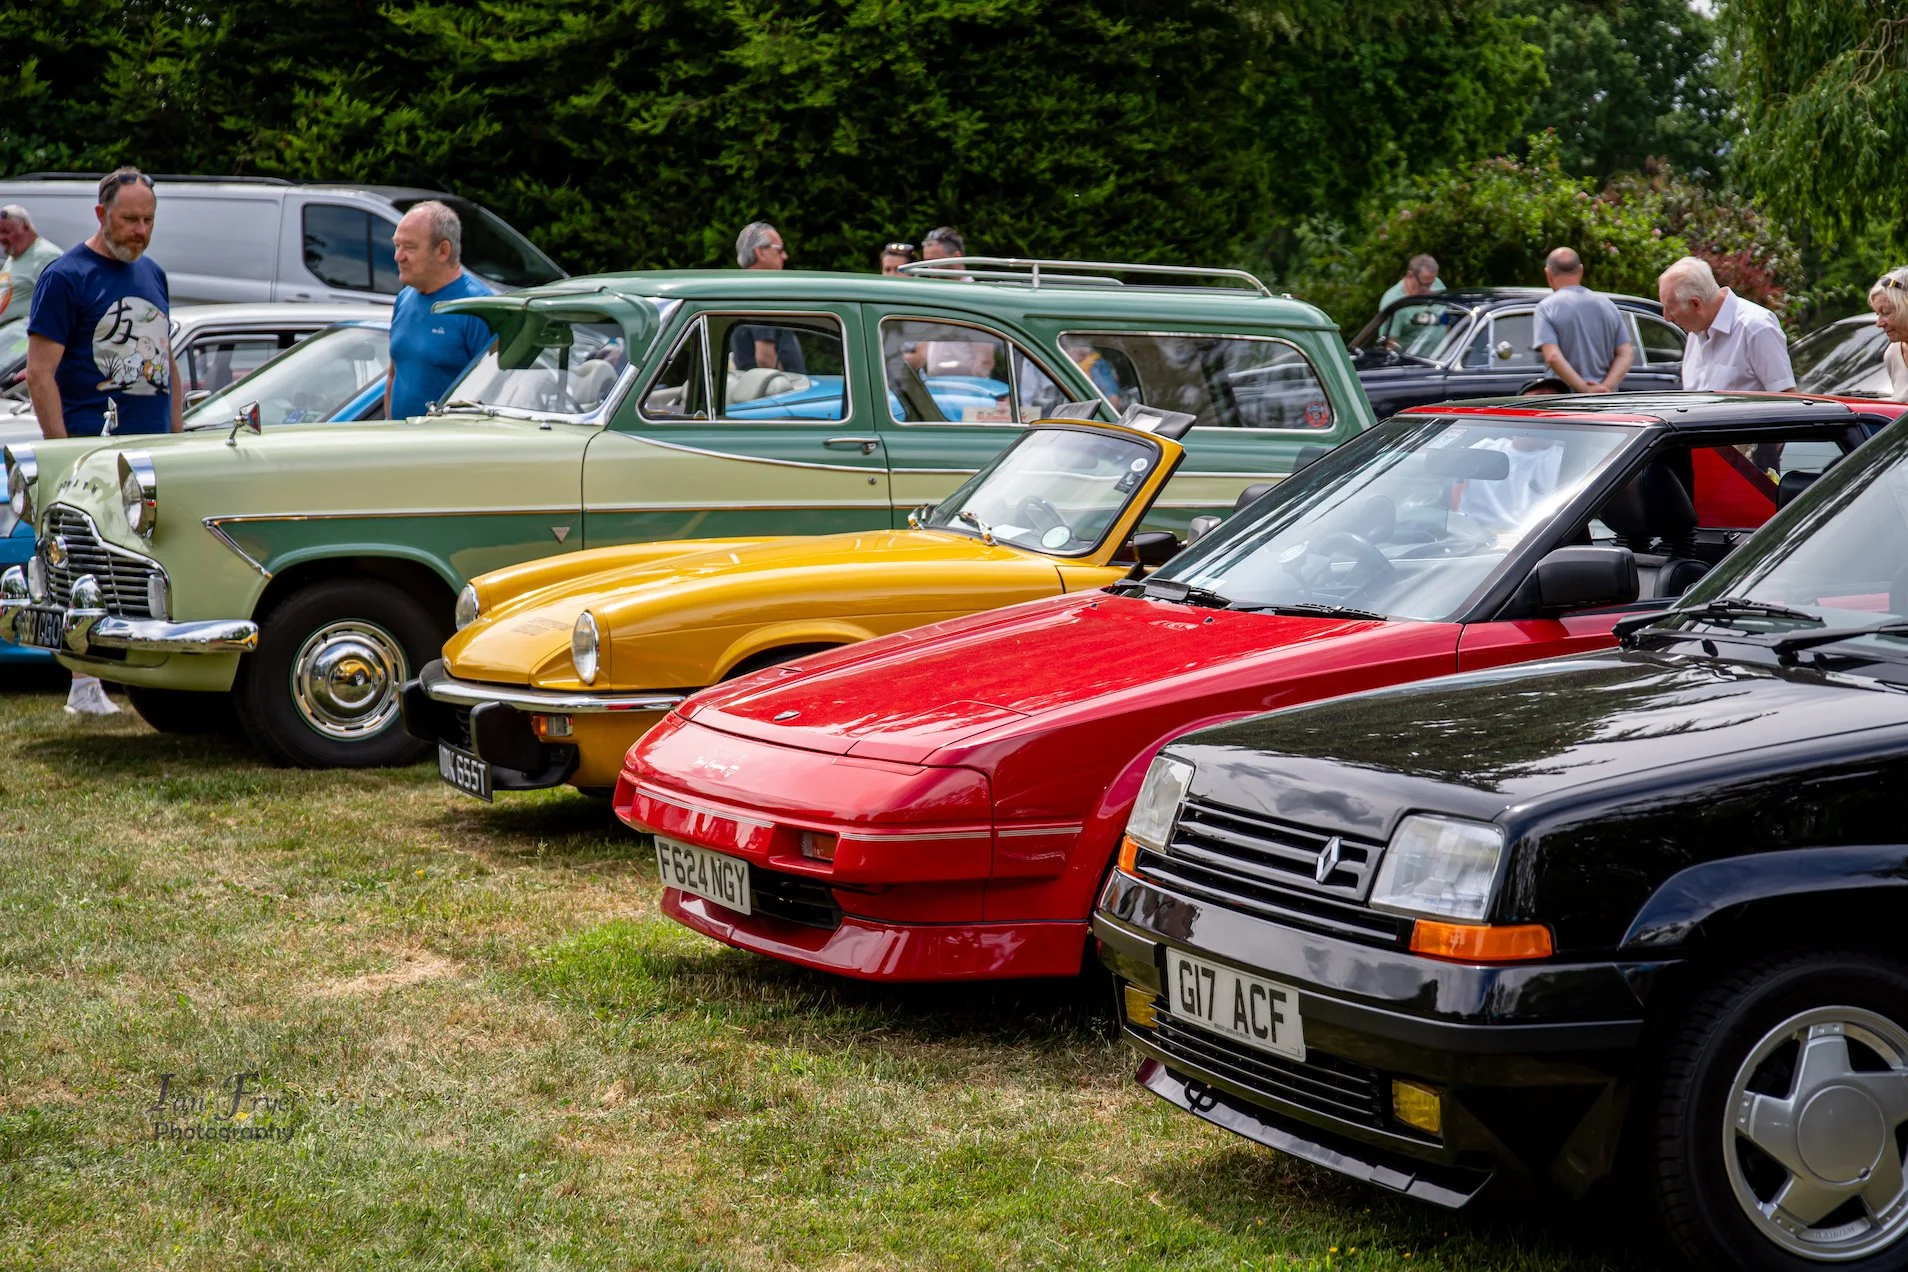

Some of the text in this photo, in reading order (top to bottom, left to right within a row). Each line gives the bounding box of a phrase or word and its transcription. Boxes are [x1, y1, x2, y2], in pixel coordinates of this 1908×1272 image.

[97, 296, 139, 344] 友
[456, 755, 485, 796] 655T
[658, 841, 745, 906] F624 NGY
[1179, 959, 1286, 1044] G17 ACF
